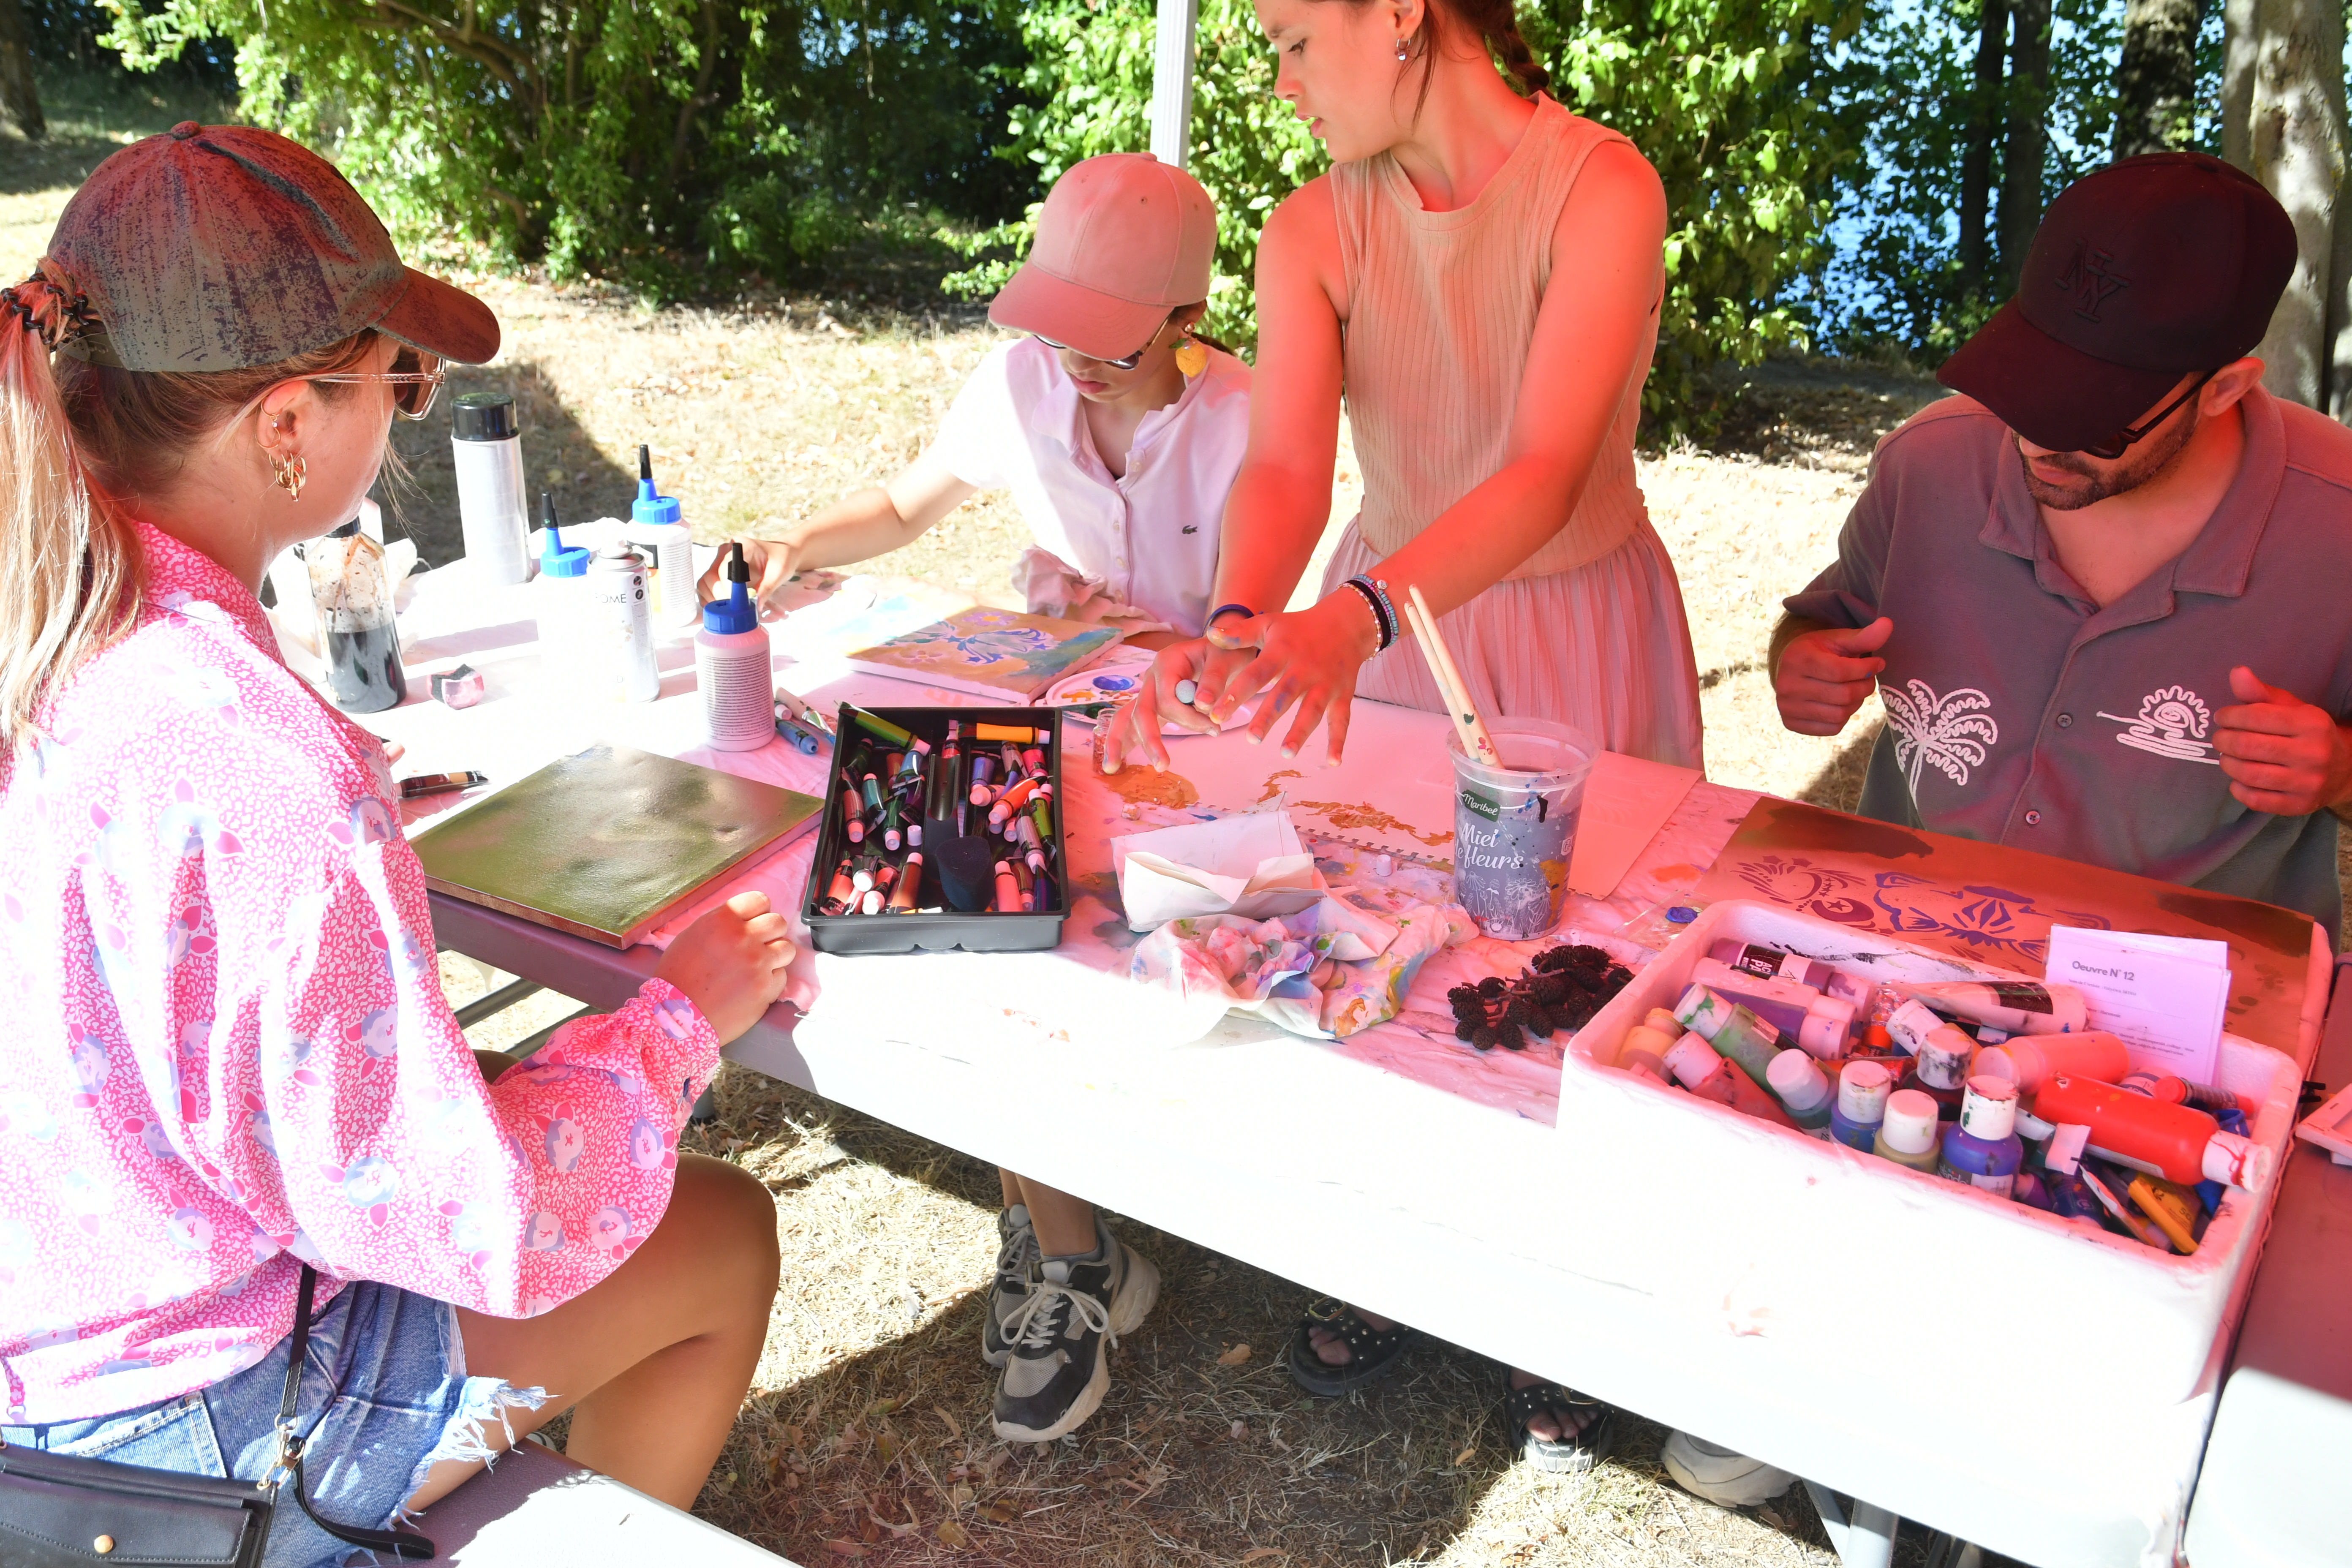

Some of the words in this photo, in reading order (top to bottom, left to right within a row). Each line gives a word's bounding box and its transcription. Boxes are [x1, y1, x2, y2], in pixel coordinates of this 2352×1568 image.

[2054, 237, 2132, 324] NY
[1464, 793, 1498, 816] Maribel
[1460, 822, 1500, 847] Miel
[1464, 844, 1524, 869] fleurs
[2072, 961, 2108, 975] Oeuvre
[2110, 968, 2122, 978] N°
[2123, 971, 2134, 981] 12
